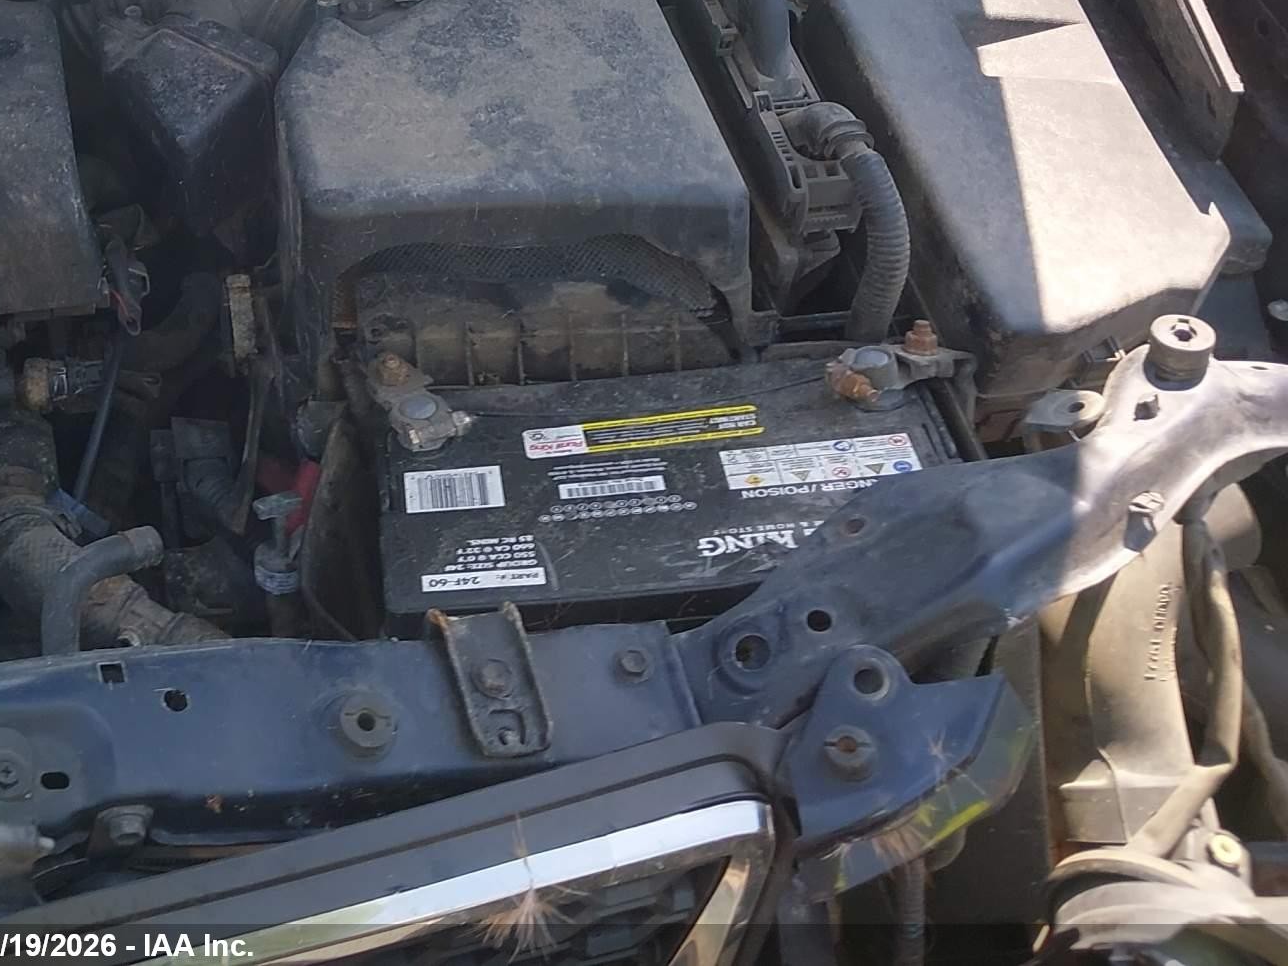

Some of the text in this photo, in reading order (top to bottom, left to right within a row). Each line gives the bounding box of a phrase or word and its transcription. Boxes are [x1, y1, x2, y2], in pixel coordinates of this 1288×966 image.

[528, 441, 583, 451] Rural King
[823, 479, 879, 492] NGER
[760, 523, 795, 532] HOME
[512, 542, 535, 551] 660
[697, 529, 799, 557] KING
[494, 544, 511, 552] CA
[488, 552, 512, 561] CCA
[496, 559, 538, 568] GROUP
[511, 572, 540, 580] PART
[429, 576, 480, 588] 24F-60
